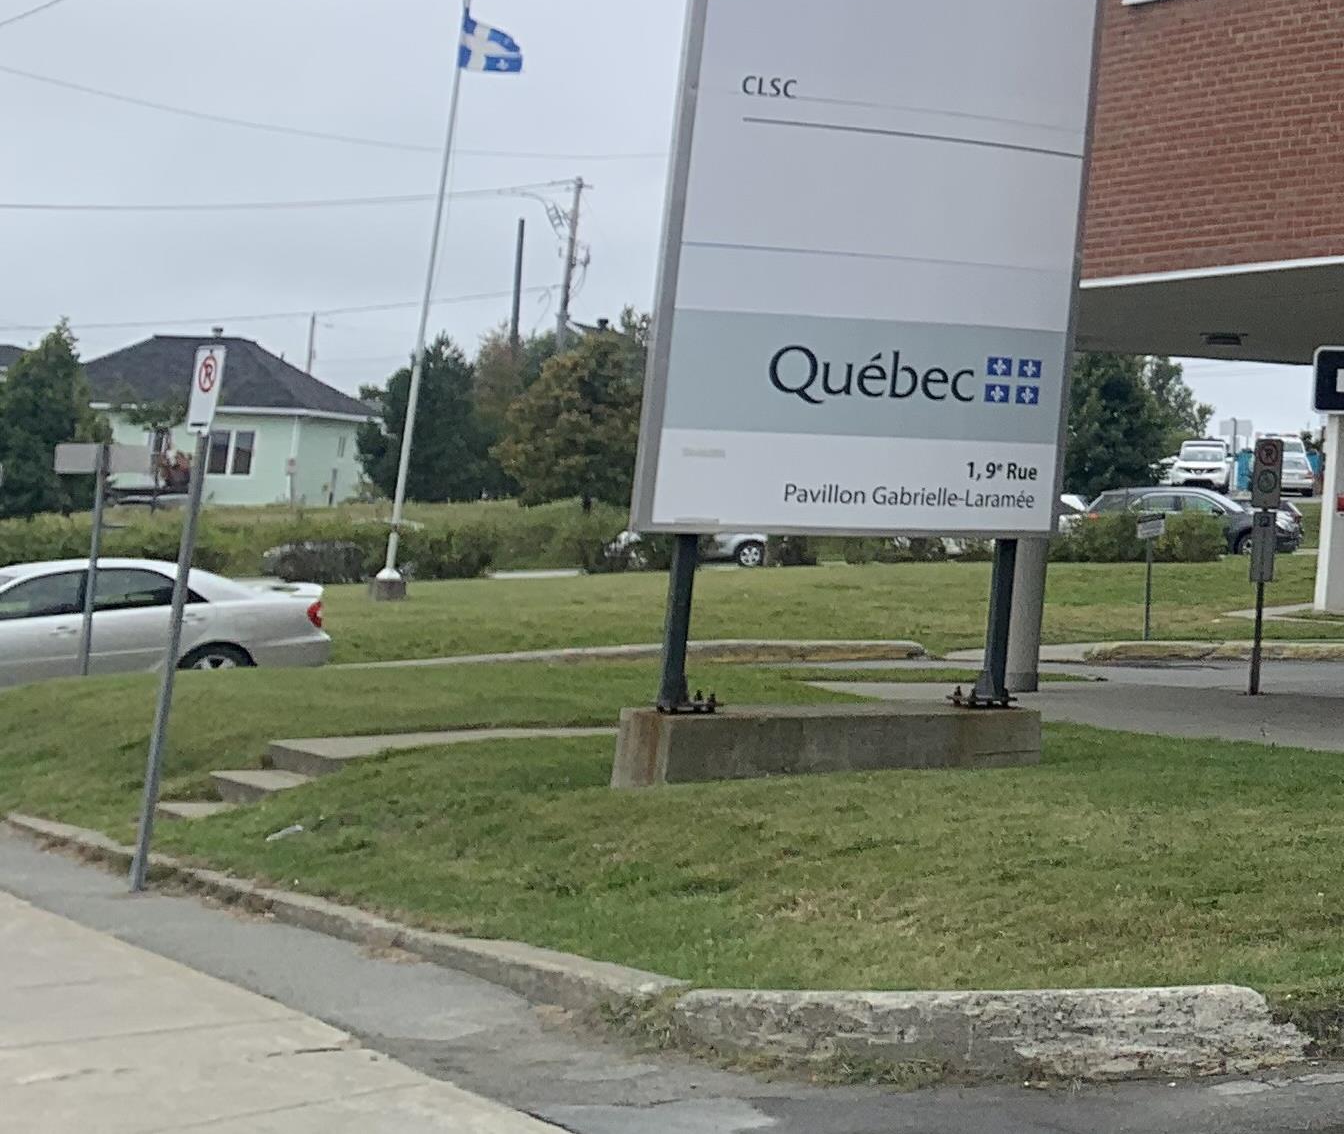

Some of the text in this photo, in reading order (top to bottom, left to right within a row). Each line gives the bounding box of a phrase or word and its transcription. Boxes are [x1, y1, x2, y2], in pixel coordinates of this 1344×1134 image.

[741, 75, 798, 99] CLSC
[768, 344, 975, 405] Québec
[1006, 463, 1038, 481] Rue
[783, 482, 1036, 509] Pavillon Gabrielle-Laramée
